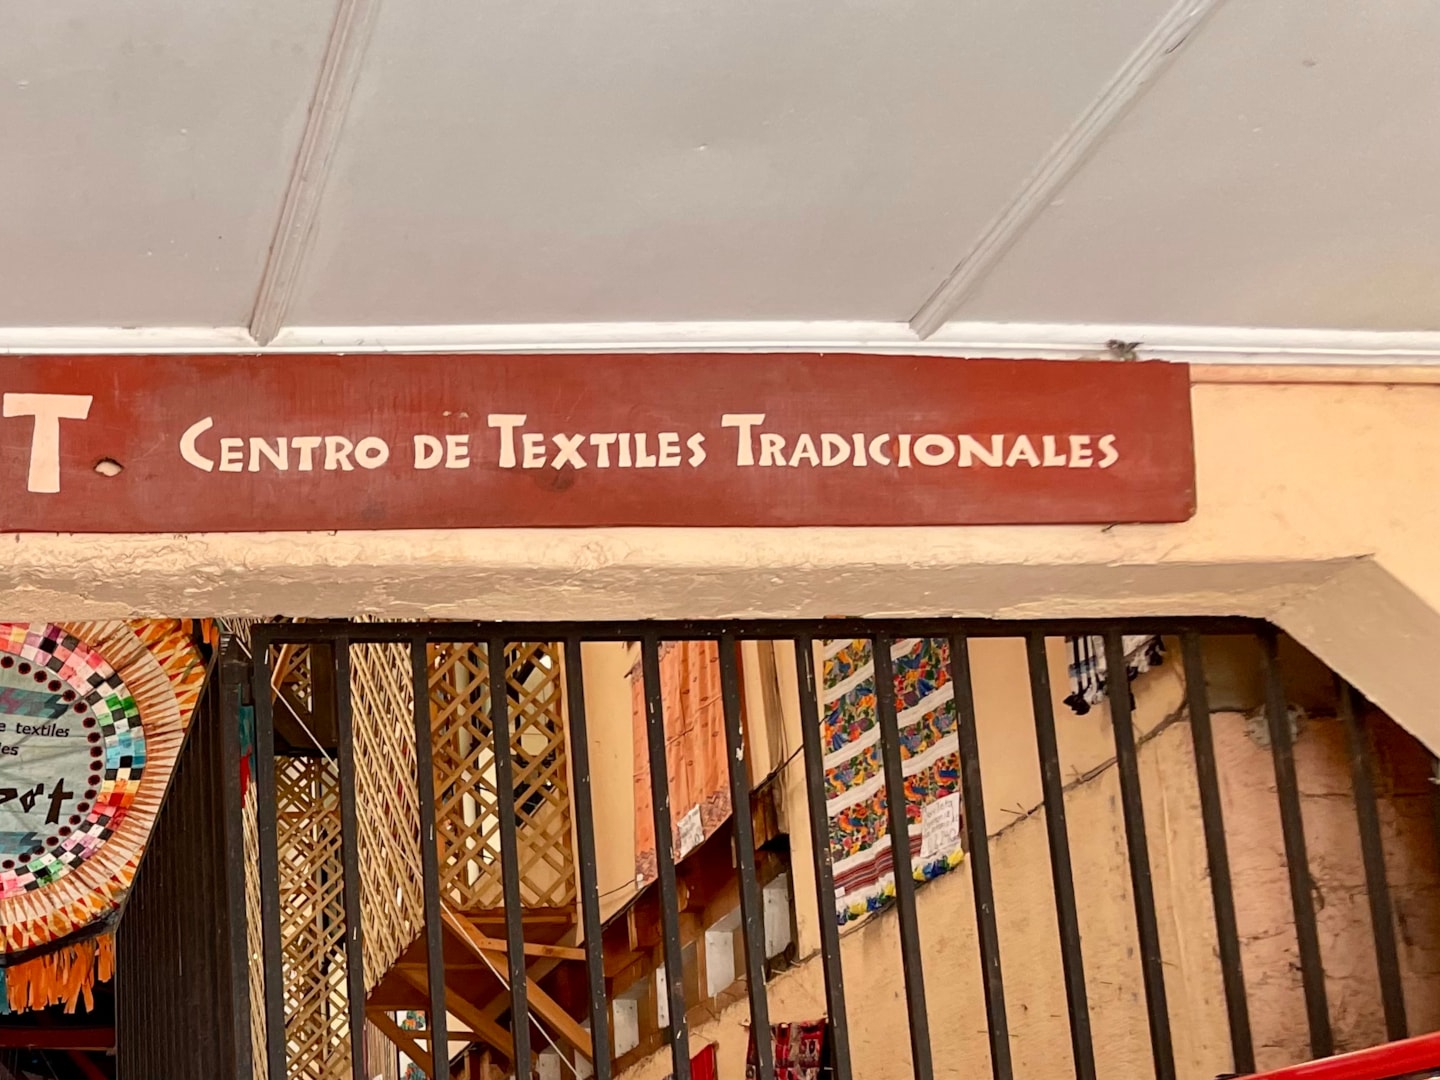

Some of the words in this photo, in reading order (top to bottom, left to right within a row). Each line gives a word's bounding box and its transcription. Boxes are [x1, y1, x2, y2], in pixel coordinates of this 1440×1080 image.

[179, 416, 390, 474] CENTRO
[413, 432, 471, 471] DE
[487, 412, 707, 472] TEXTILES
[721, 412, 1121, 471] TRADICIONALES
[16, 719, 70, 739] textiles
